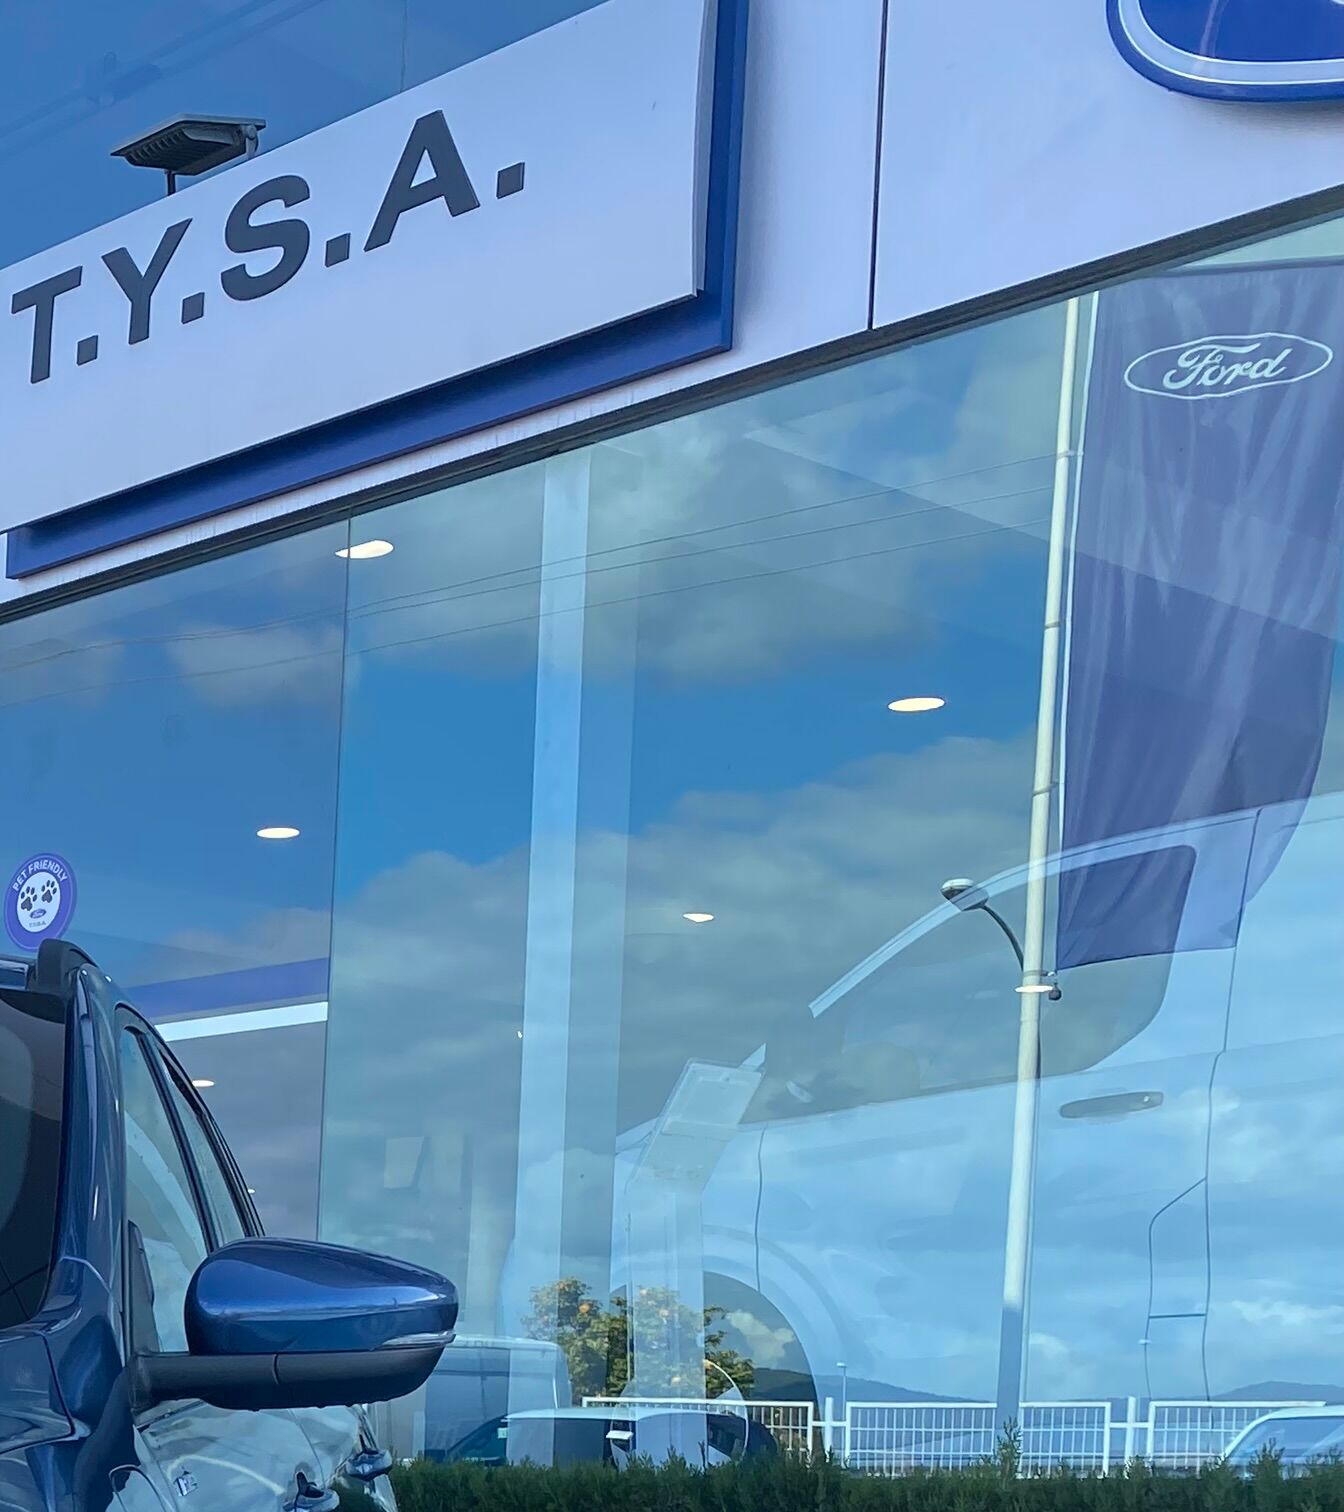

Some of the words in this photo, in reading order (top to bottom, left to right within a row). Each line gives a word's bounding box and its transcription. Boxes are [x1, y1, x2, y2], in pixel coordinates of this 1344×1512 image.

[12, 109, 526, 384] T.Y.S.A.
[1162, 342, 1293, 391] Ford
[12, 869, 28, 892] PET
[28, 859, 68, 882] FRIENDLY
